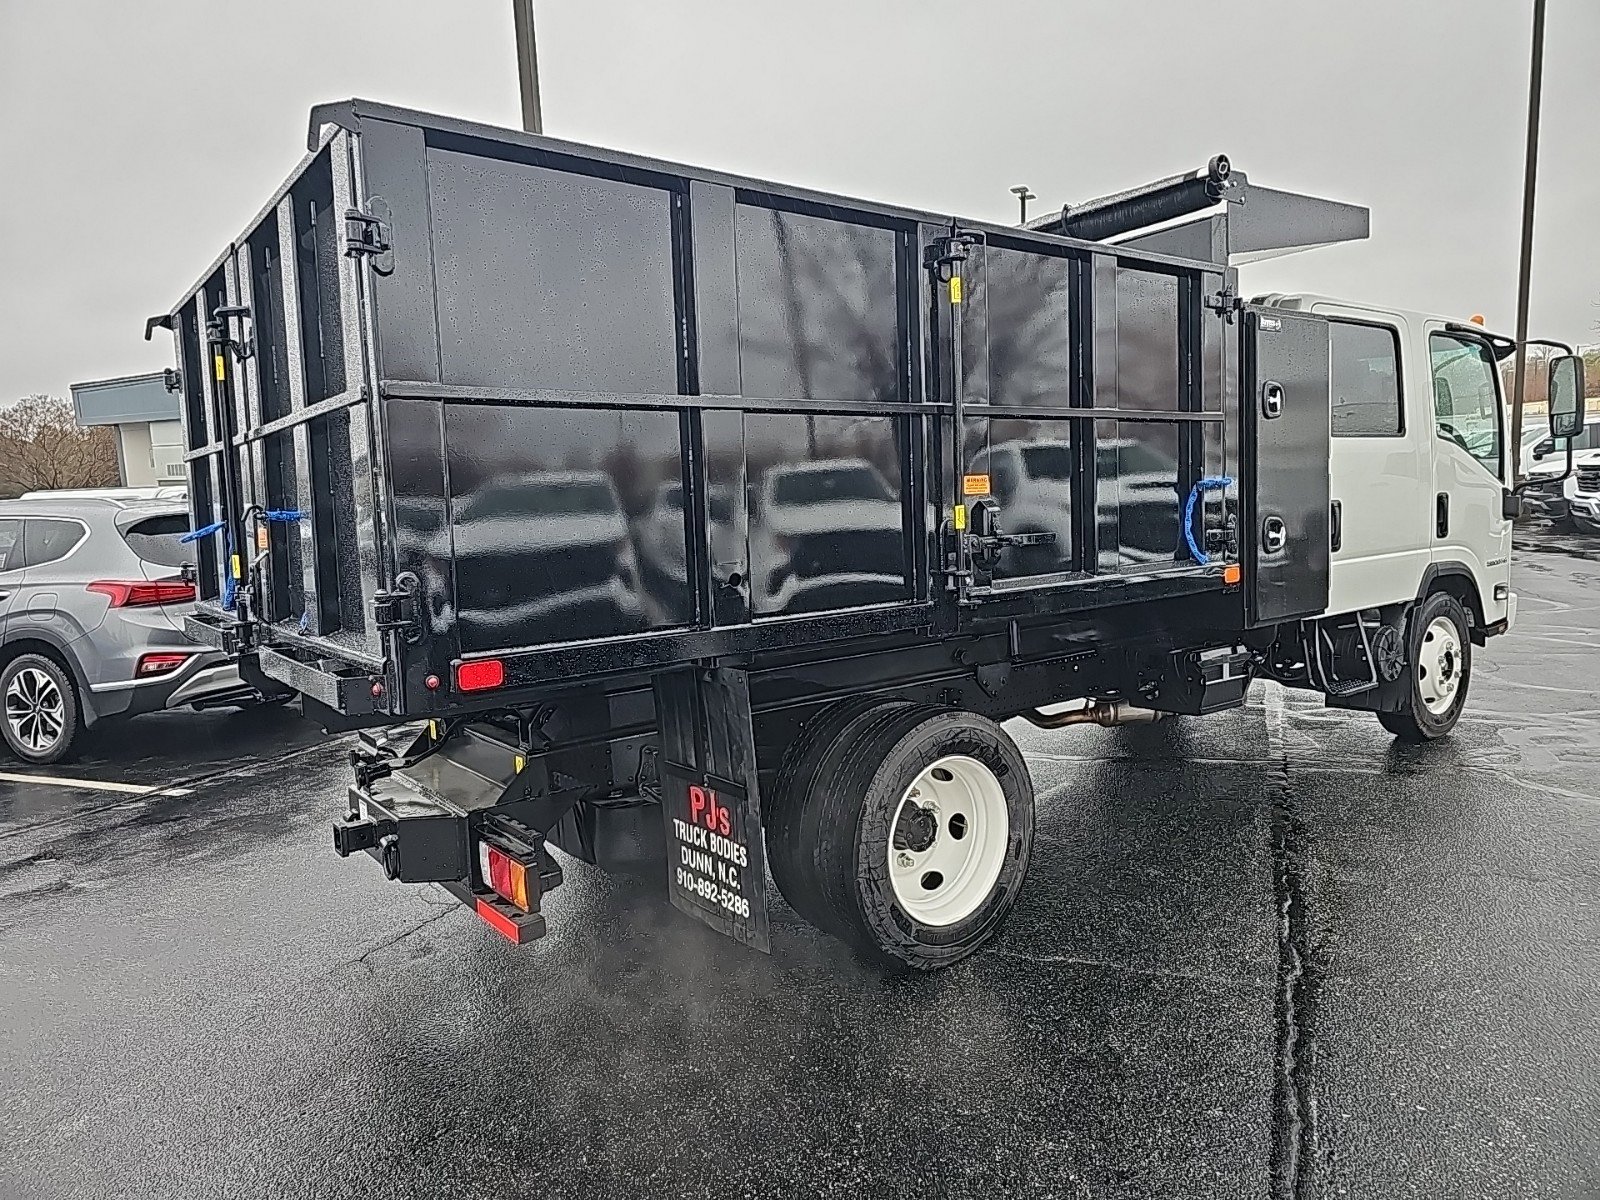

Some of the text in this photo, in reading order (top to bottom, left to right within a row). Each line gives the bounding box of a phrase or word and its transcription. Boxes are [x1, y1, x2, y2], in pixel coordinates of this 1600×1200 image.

[673, 818, 748, 868] TRUCK BODIES
[681, 845, 741, 890] DUNN, N.C.
[676, 867, 750, 918] 910-892-5286
